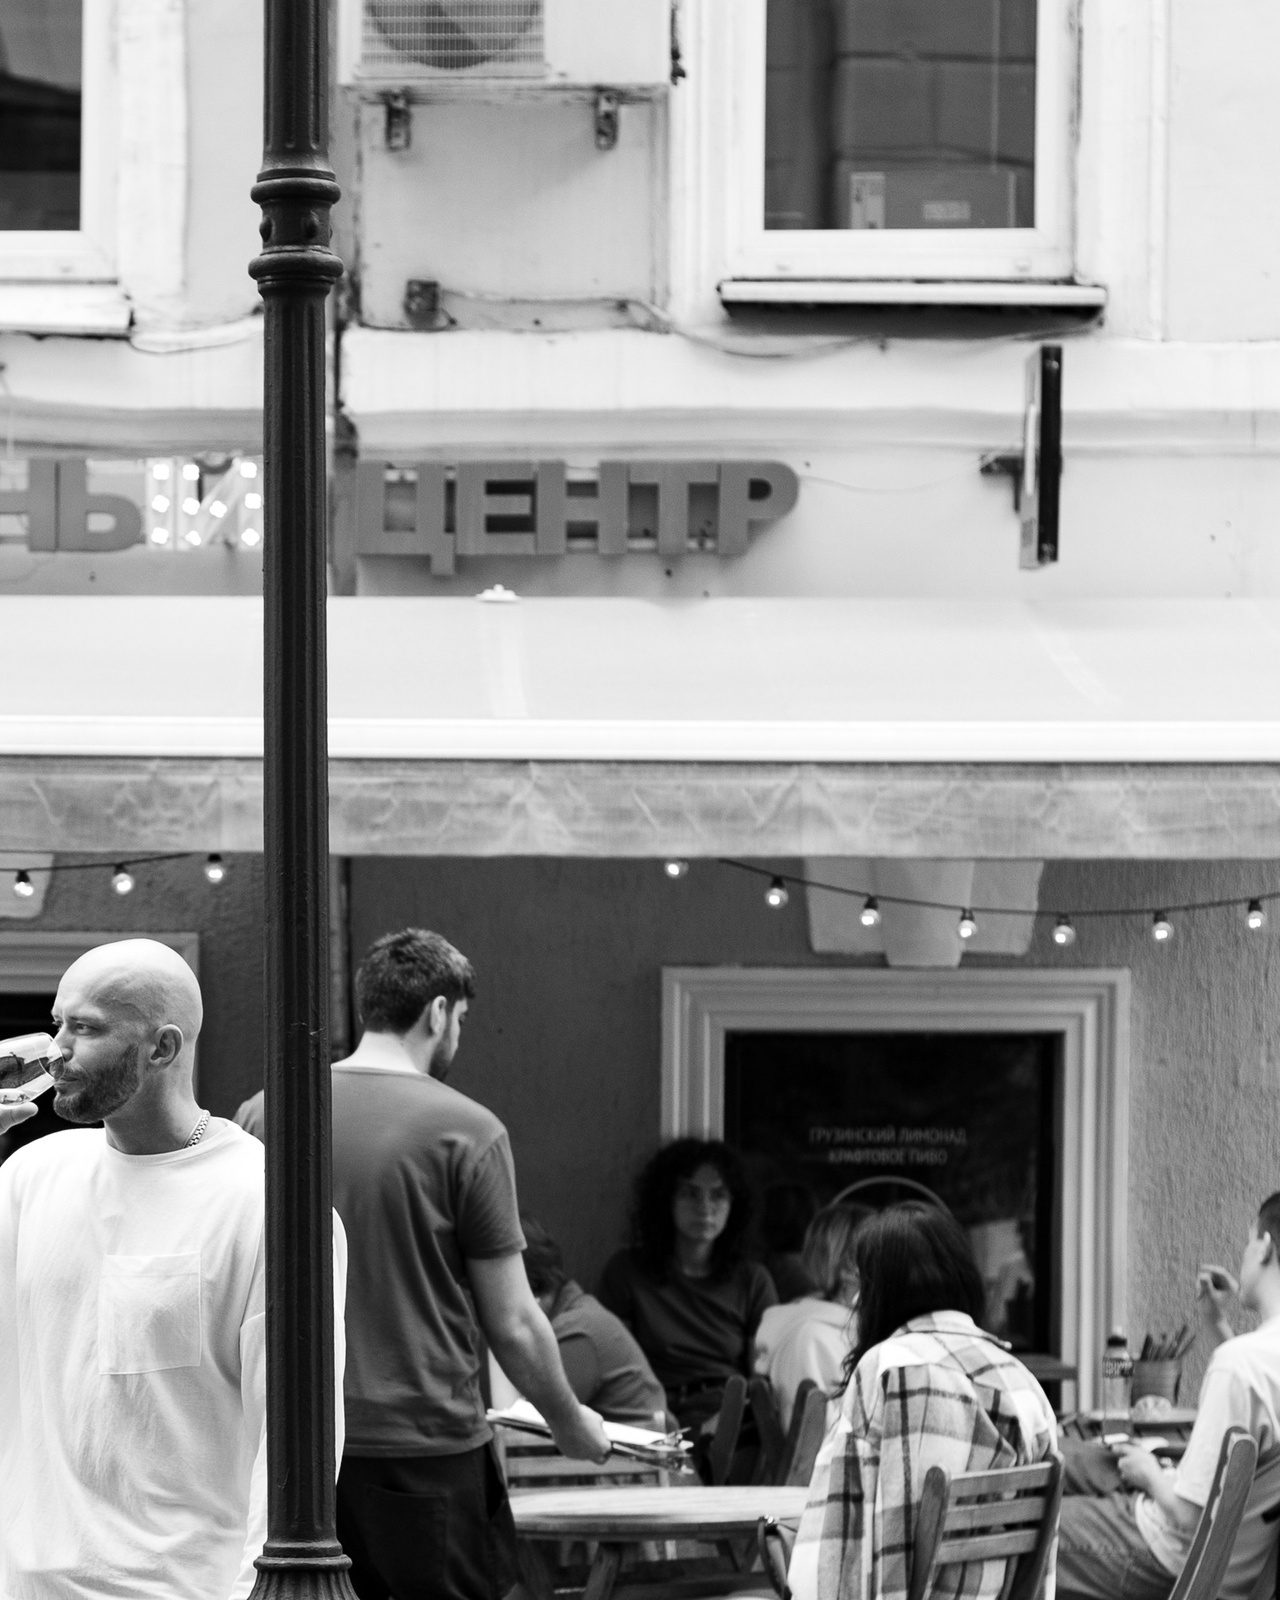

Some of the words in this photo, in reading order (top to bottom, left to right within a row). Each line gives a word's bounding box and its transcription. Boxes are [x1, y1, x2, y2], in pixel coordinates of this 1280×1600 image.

[357, 459, 800, 576] ЦЕНТР
[809, 1124, 896, 1143] ГРУЗИНСКИЙ
[897, 1126, 968, 1145] ЛИМОНАД
[829, 1147, 906, 1165] КРАФТОВОЕ
[907, 1148, 949, 1166] ПИВО
